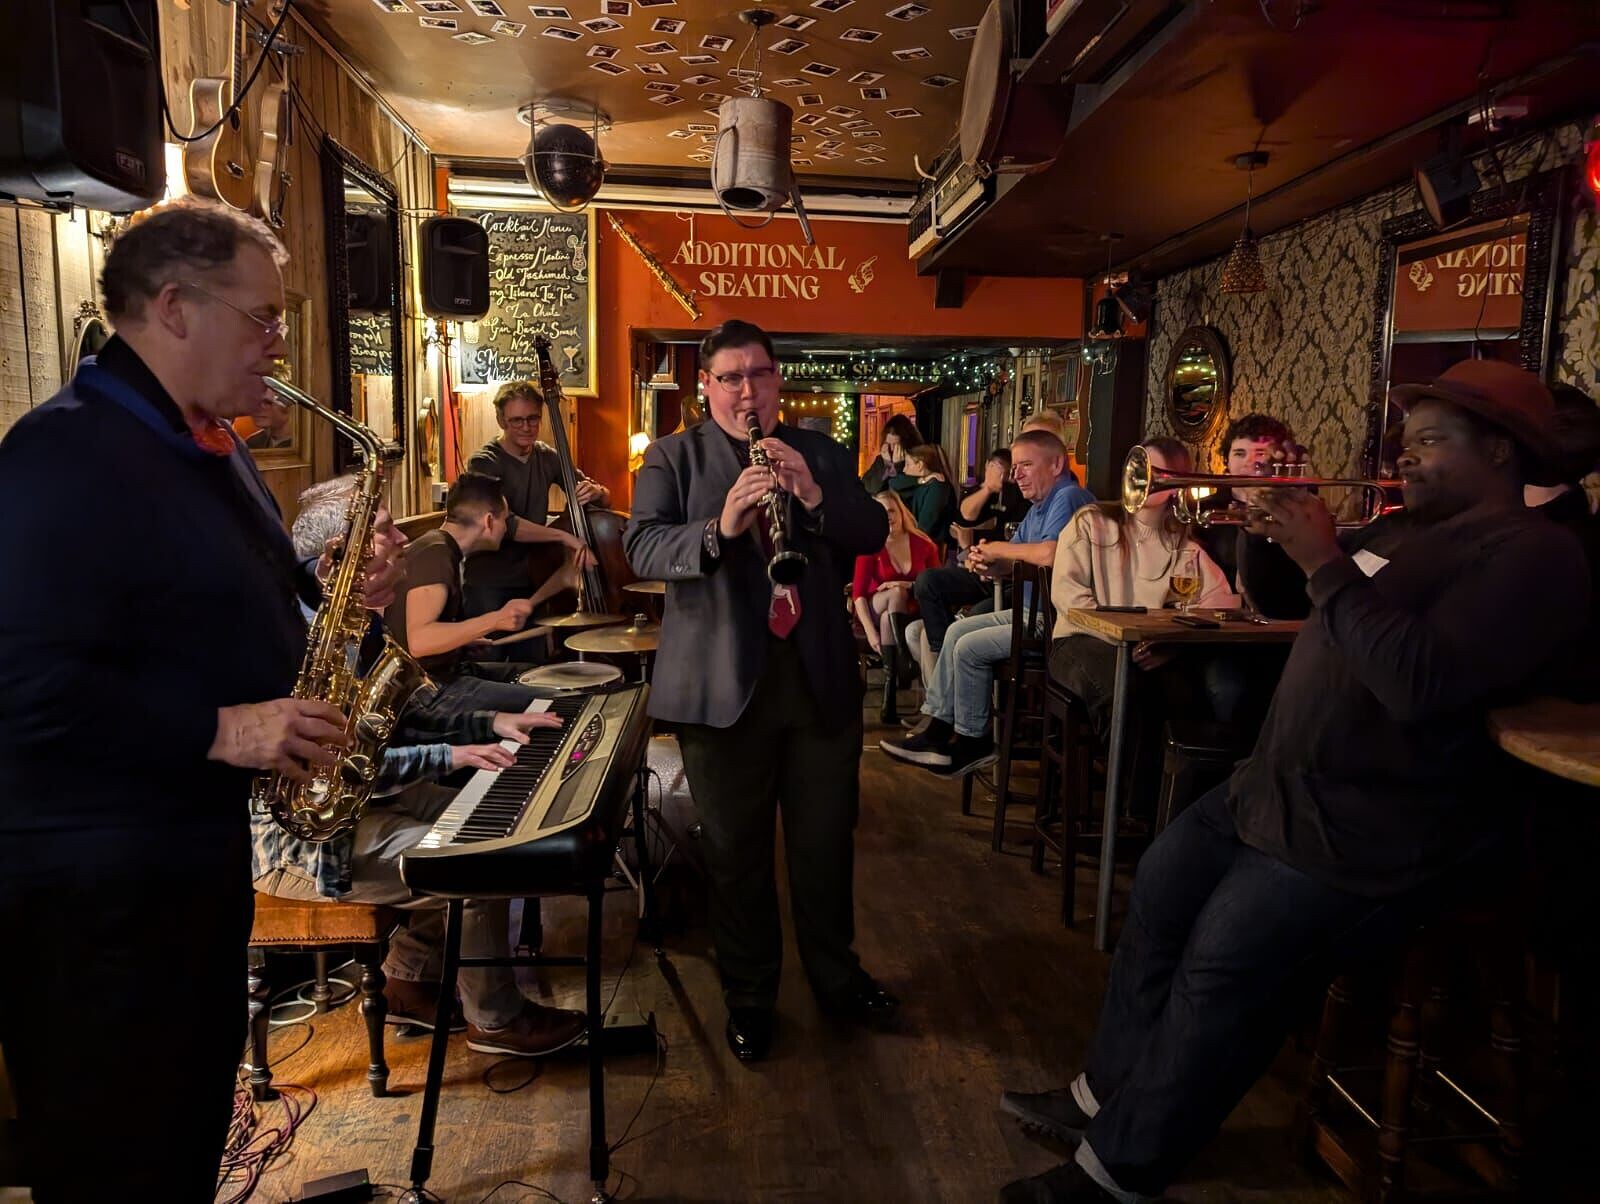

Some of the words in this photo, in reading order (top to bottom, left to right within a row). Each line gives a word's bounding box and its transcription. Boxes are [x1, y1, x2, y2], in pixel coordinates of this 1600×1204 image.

[479, 213, 539, 234] Cocktail
[534, 217, 572, 239] Menu
[488, 244, 535, 268] Espresso
[530, 246, 570, 268] Martini
[671, 241, 846, 271] ADDITIONAL
[494, 268, 514, 282] Old
[517, 267, 570, 287] Fashioned
[699, 271, 820, 301] SEATING
[505, 284, 540, 301] Island
[557, 285, 575, 307] Tea
[483, 317, 511, 341] Gin
[513, 319, 549, 337] Basil
[549, 321, 581, 339] Smash
[478, 348, 536, 371] Margarit
